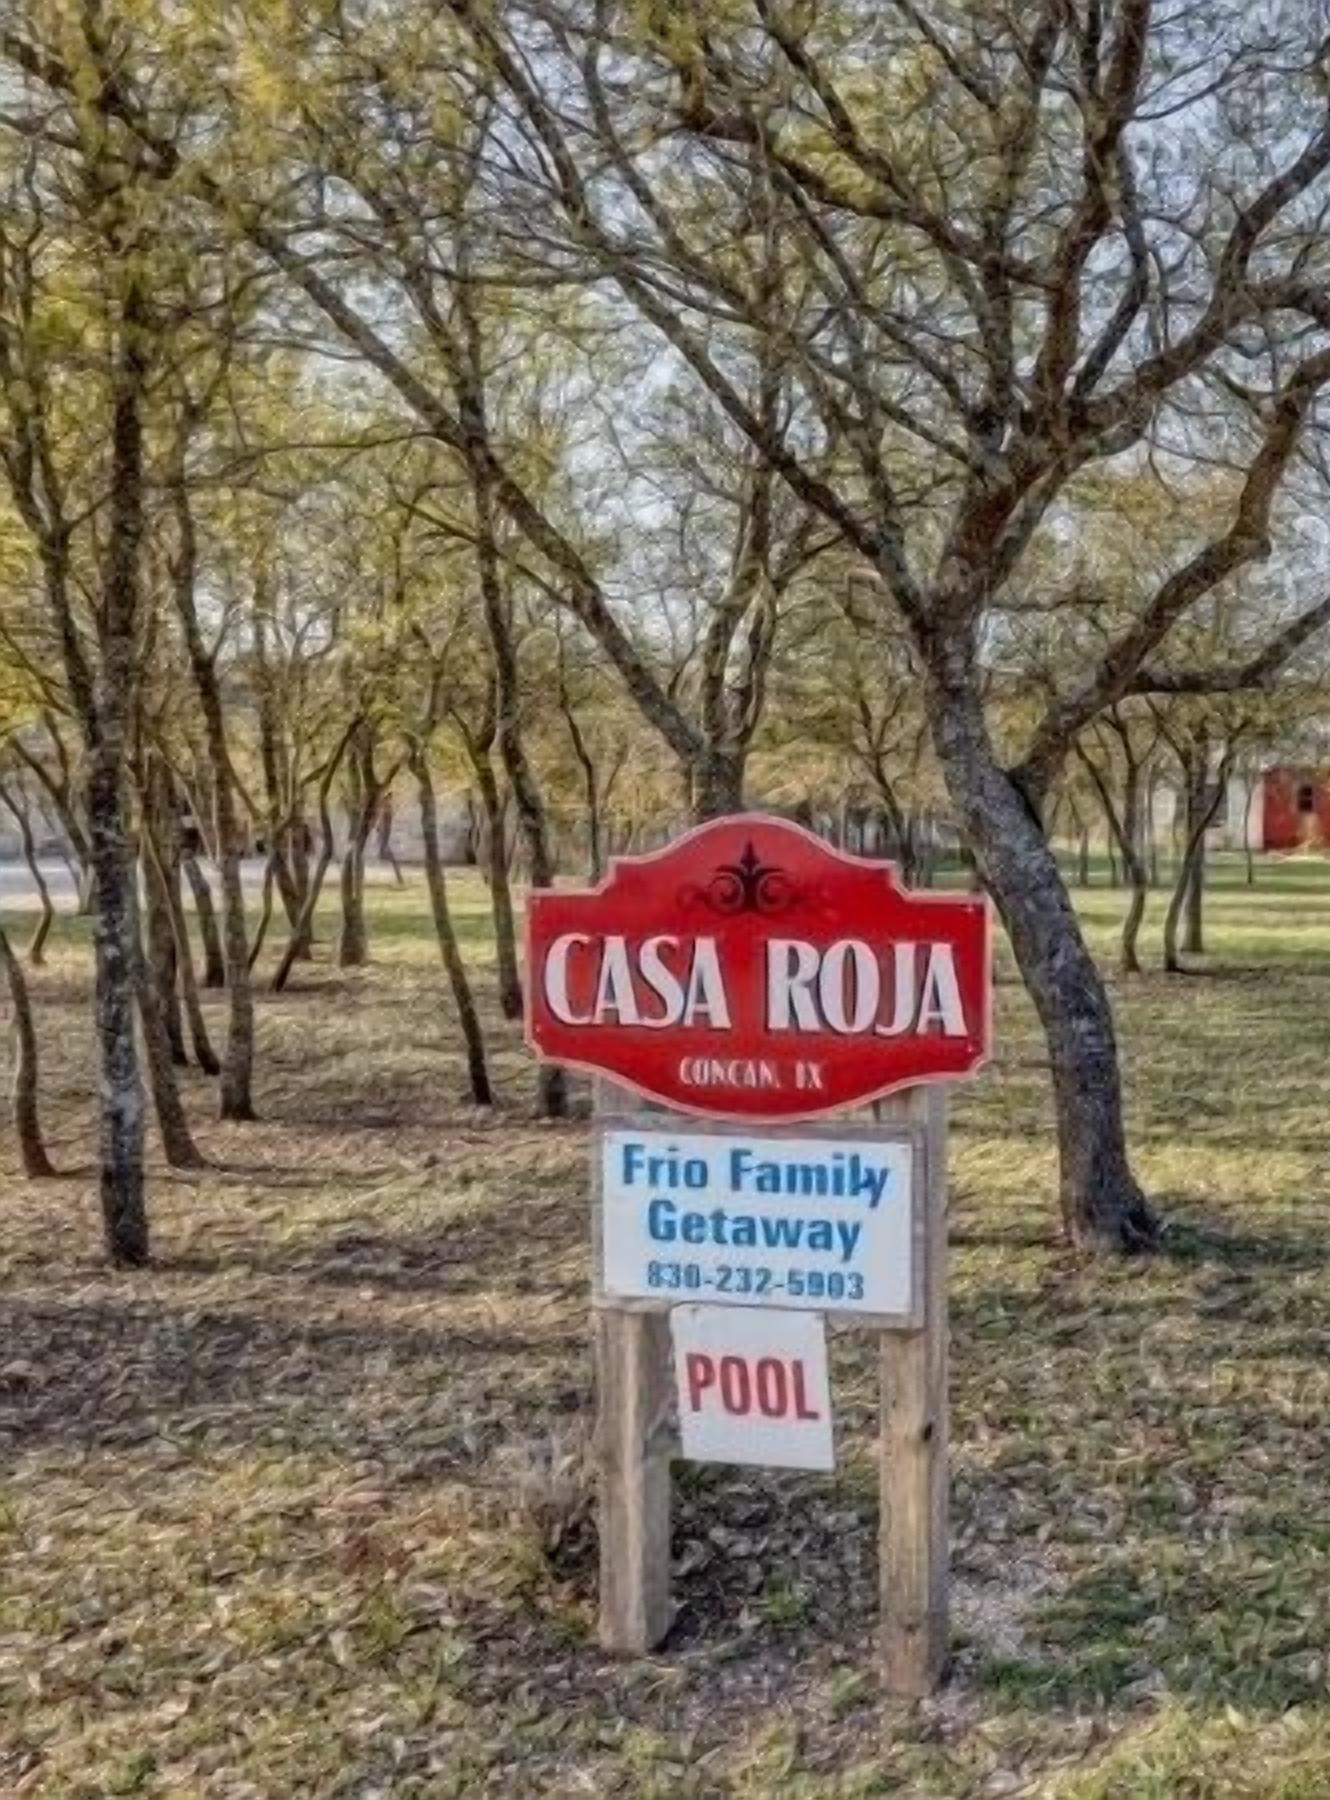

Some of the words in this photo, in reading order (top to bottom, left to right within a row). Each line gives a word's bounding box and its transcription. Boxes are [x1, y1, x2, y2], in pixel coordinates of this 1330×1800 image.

[545, 932, 732, 1030] CASA
[766, 938, 968, 1037] ROJA
[622, 1143, 708, 1189] Frio
[730, 1147, 890, 1209] Family
[647, 1199, 862, 1262] Getaway
[647, 1260, 865, 1300] 830-232-5903
[685, 1352, 819, 1420] POOL
